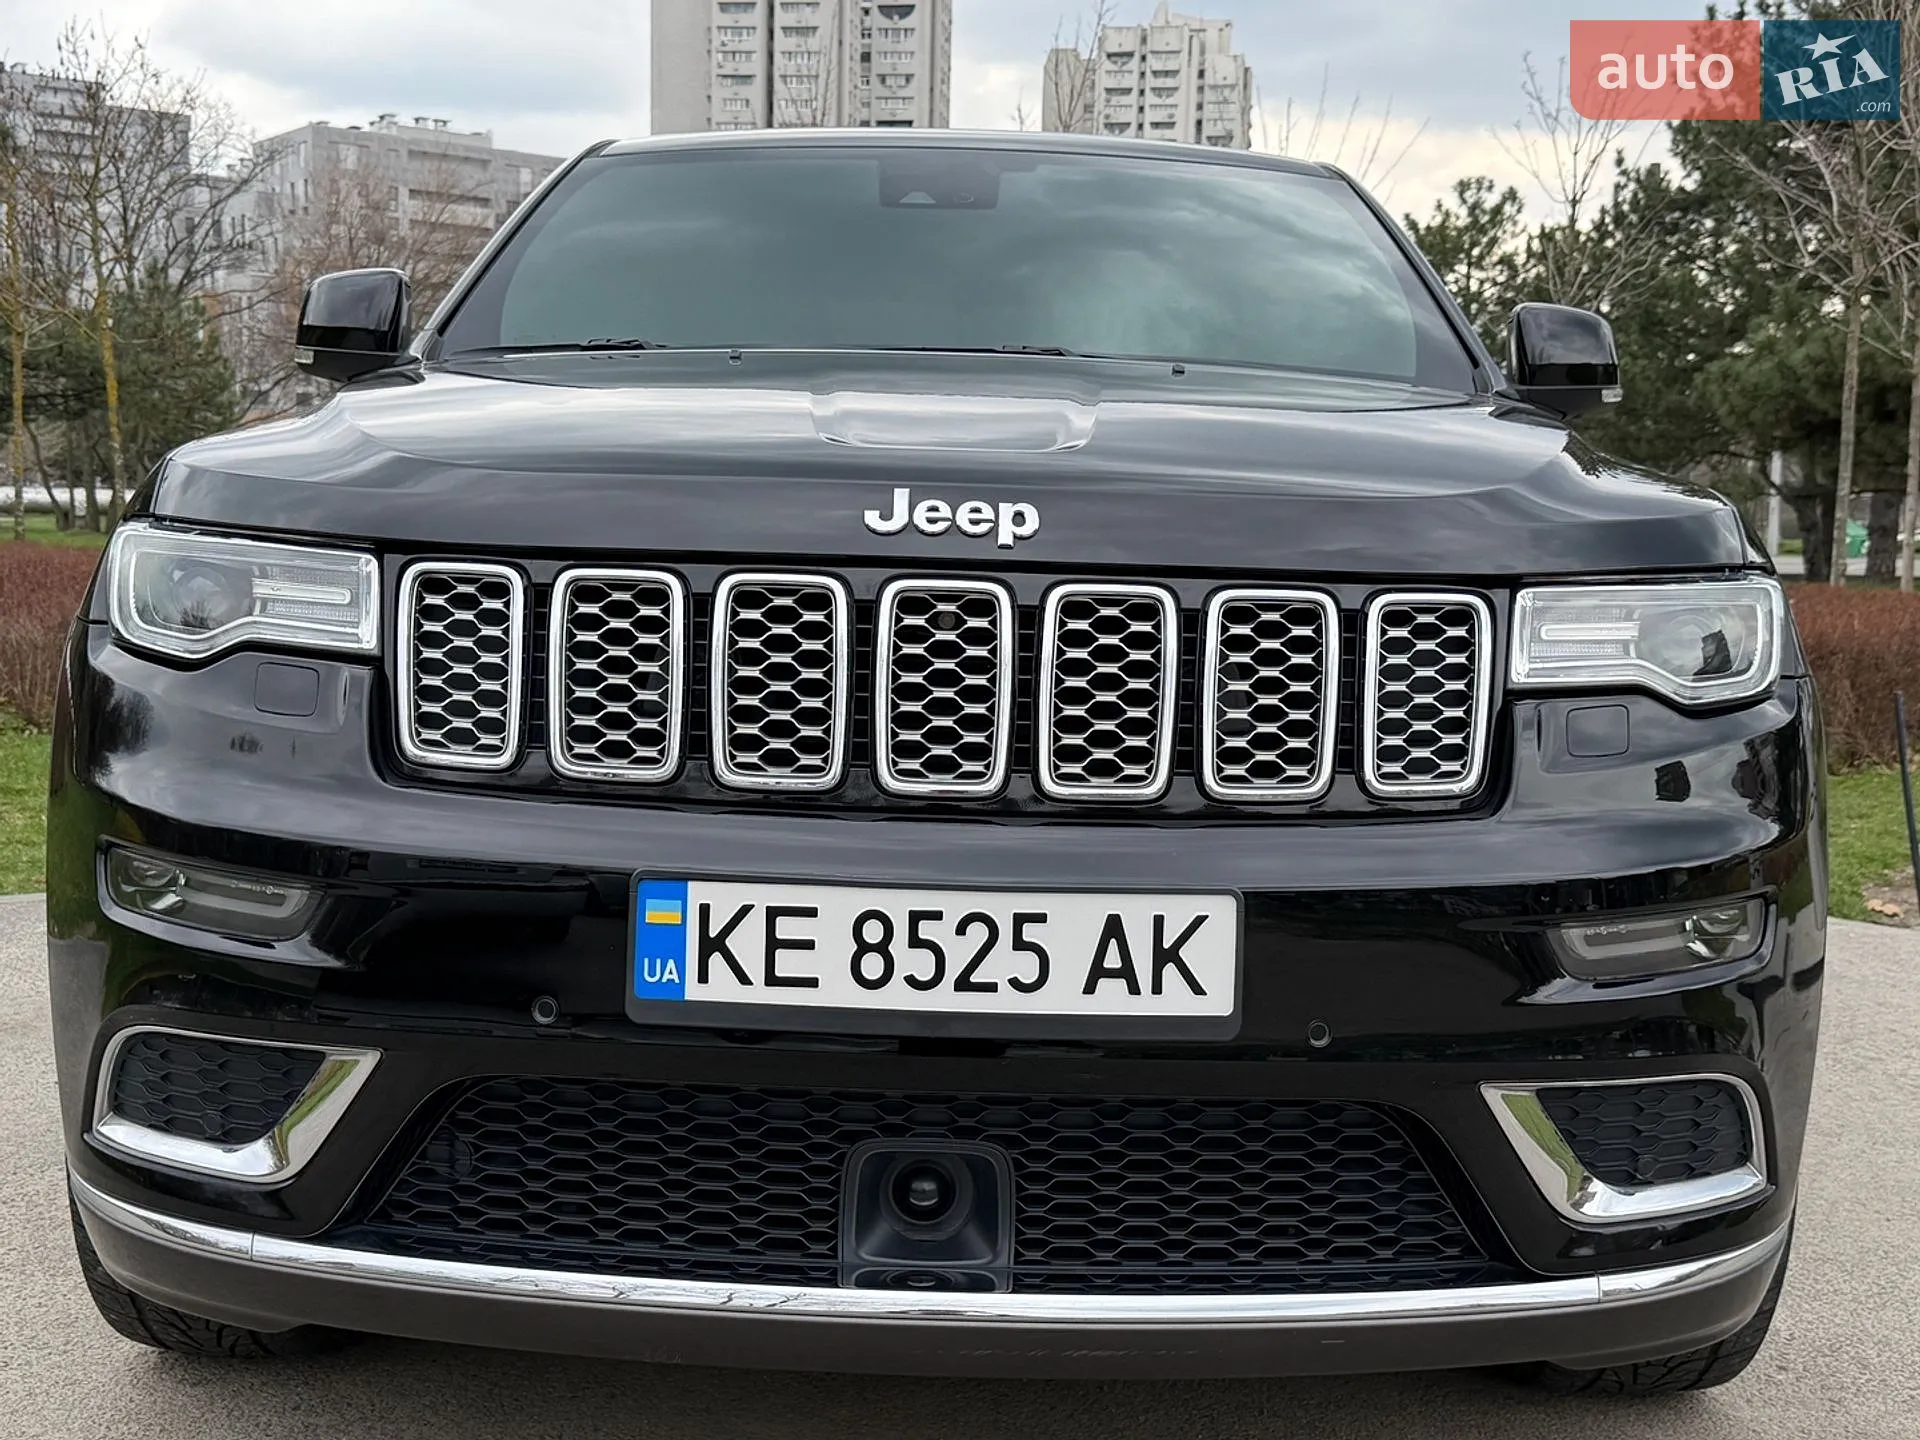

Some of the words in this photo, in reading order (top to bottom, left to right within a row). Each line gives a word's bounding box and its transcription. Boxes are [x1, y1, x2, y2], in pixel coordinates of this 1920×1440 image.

[863, 487, 1040, 550] Jeep
[642, 957, 681, 985] UA
[696, 902, 820, 989] KE
[849, 908, 1052, 995] 8525
[1081, 912, 1211, 997] AK
